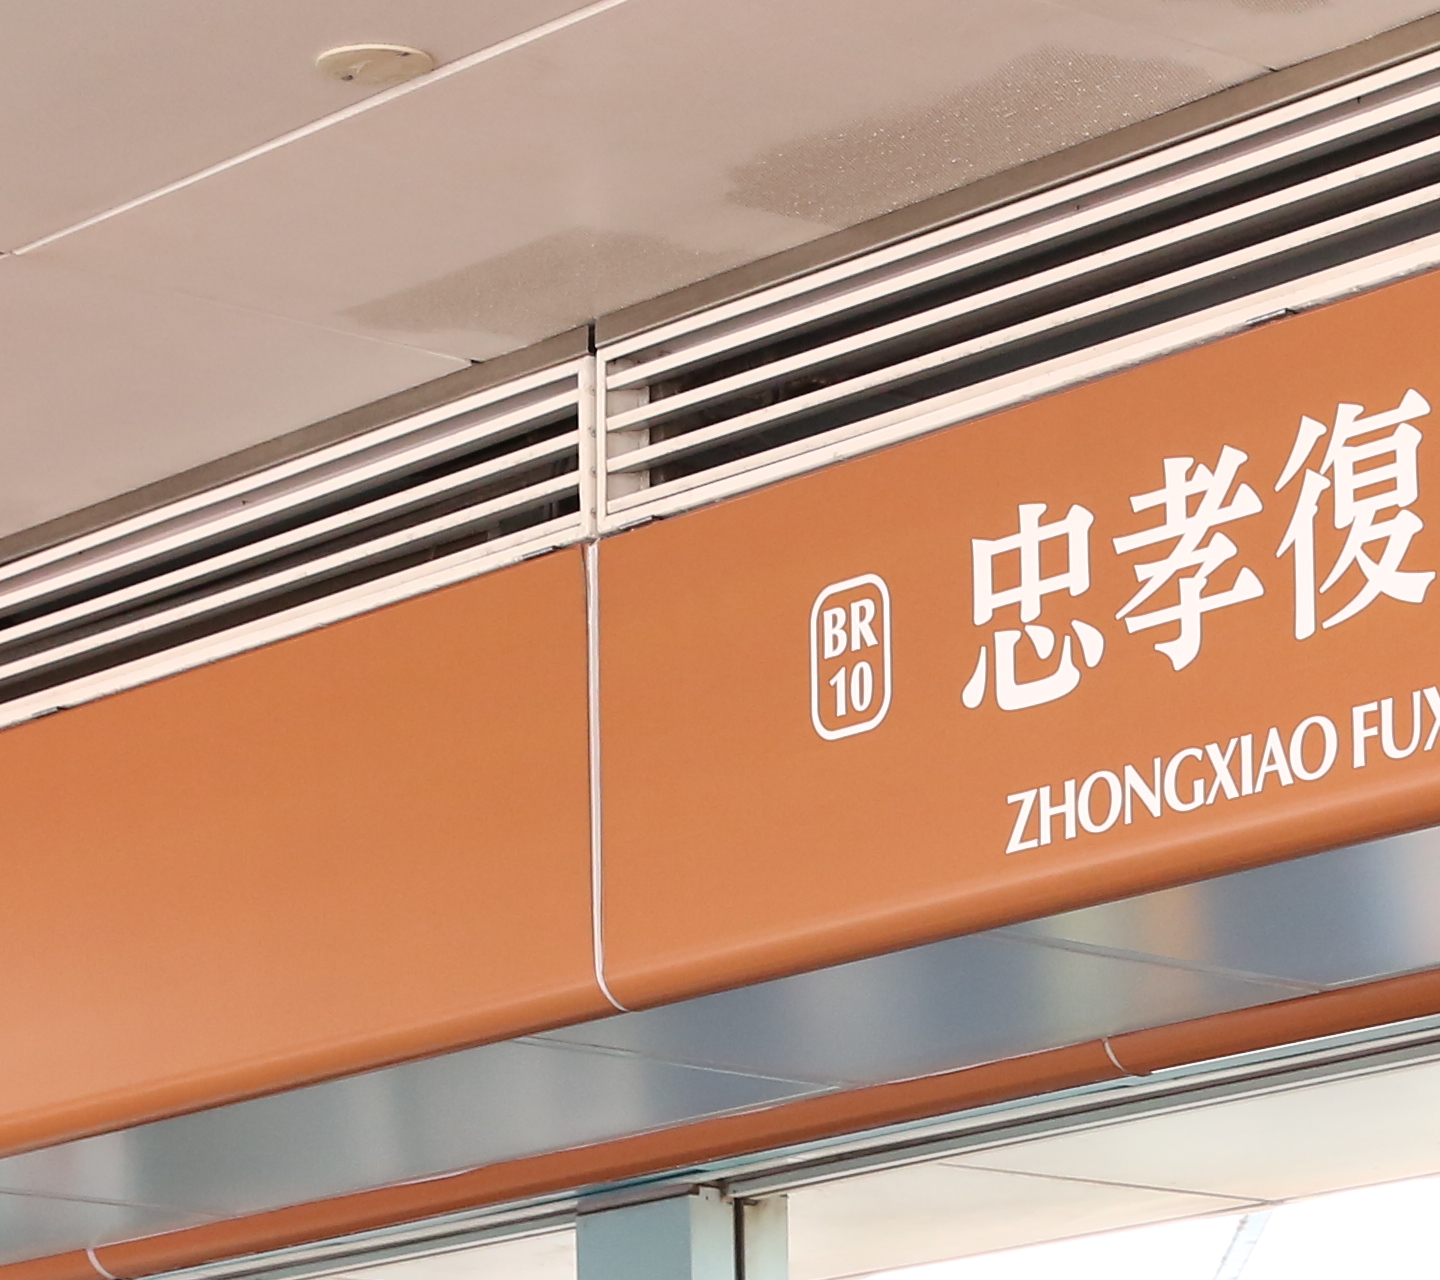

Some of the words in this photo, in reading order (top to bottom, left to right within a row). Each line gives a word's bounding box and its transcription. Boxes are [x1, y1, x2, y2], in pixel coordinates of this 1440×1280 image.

[823, 598, 880, 659] BR
[825, 659, 876, 722] 10
[1003, 714, 1339, 855] ZHONGXIAO
